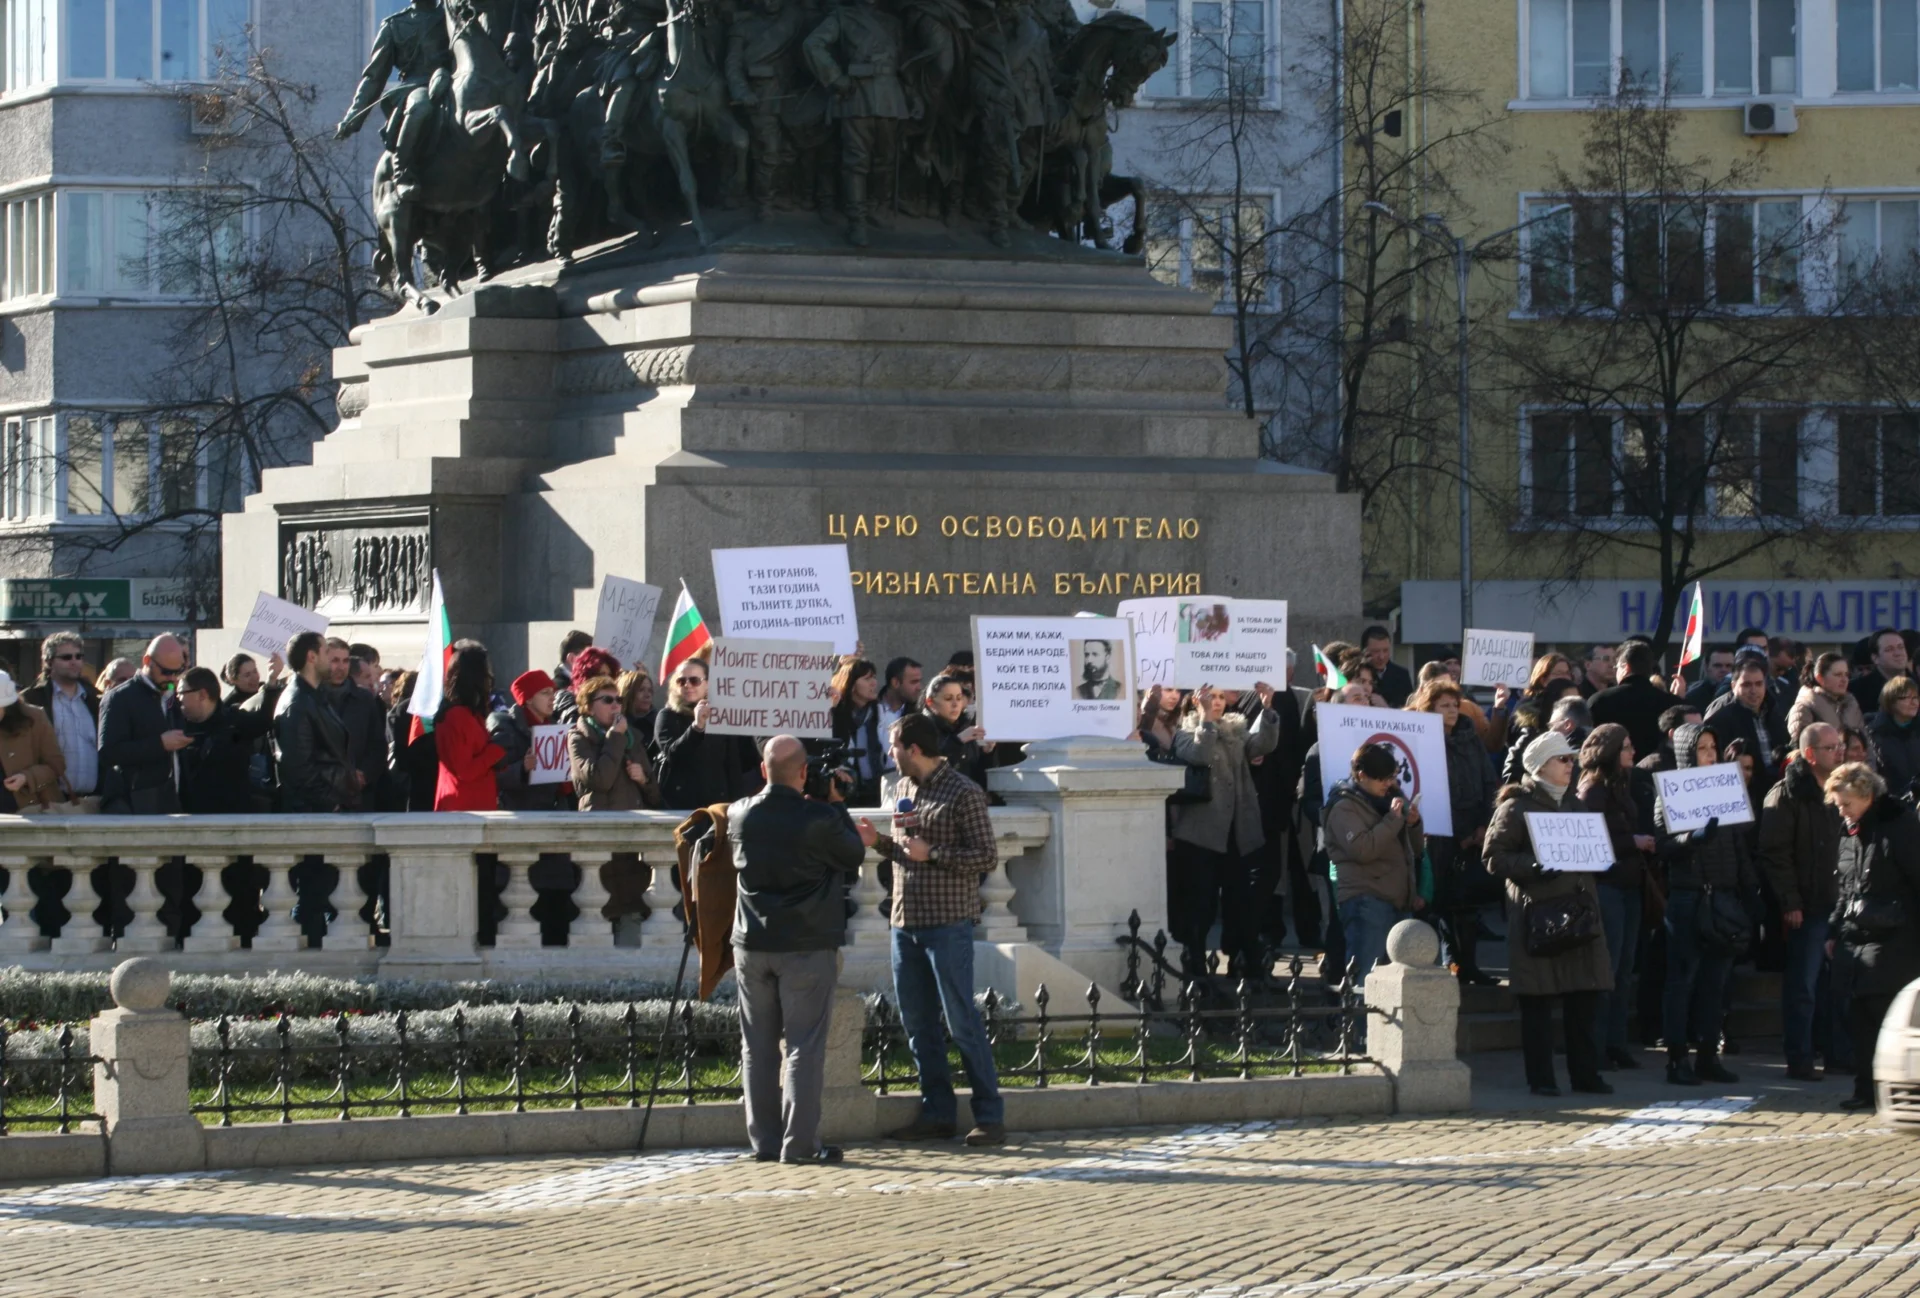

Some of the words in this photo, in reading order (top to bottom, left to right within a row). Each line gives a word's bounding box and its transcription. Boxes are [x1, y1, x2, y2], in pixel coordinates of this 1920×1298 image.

[828, 513, 918, 541] ЦАРЮ
[941, 514, 1200, 542] ОСВОБОДИТЕЛЮ
[767, 567, 818, 579] ГОРАНОВ,
[749, 584, 776, 595] ТАЗИ
[779, 583, 820, 595] ГОДИНА
[850, 571, 1037, 595] РИЗНАТЕЛНА
[1054, 572, 1201, 596] БЪЛГАРИЯ
[741, 600, 793, 611] ПЪЛНИТЕ
[795, 598, 832, 610] ДУПКА,
[986, 631, 1013, 640] КАЖИ
[1016, 631, 1033, 641] МИ,
[1035, 631, 1064, 641] КАЖИ,
[986, 647, 1025, 658] БЕДНИЙ
[1027, 647, 1068, 658] НАРОДЕ,
[1190, 651, 1211, 659] ТОВА
[1212, 651, 1224, 659] ЛИ
[1225, 651, 1230, 659] Е
[1235, 651, 1267, 660] НАШЕТО
[997, 664, 1016, 674] КОЙ
[1019, 665, 1029, 674] ТЕ
[1033, 665, 1039, 674] В
[1042, 665, 1059, 674] ТАЗ
[1137, 658, 1175, 683] РУГ
[1200, 664, 1230, 672] СВЕТЛО
[1481, 662, 1514, 681] ОБИР
[716, 677, 735, 697] НЕ
[742, 679, 799, 699] СТИГАТ
[806, 681, 830, 700] ЗА
[992, 682, 1030, 691] РАБСКА
[1032, 682, 1066, 691] ЛЮЛКА
[1009, 699, 1049, 708] ЛЮЛЕЕ?
[708, 707, 768, 728] ВАШИТЕ
[772, 709, 833, 729] ЗАПЛАТИ
[1361, 718, 1374, 729] НА
[1375, 719, 1425, 734] КРАЖБАТА!
[1536, 817, 1604, 840] НАРОДЕ,
[1538, 842, 1594, 865] СЪБУДИ
[1594, 843, 1615, 863] СЕ
